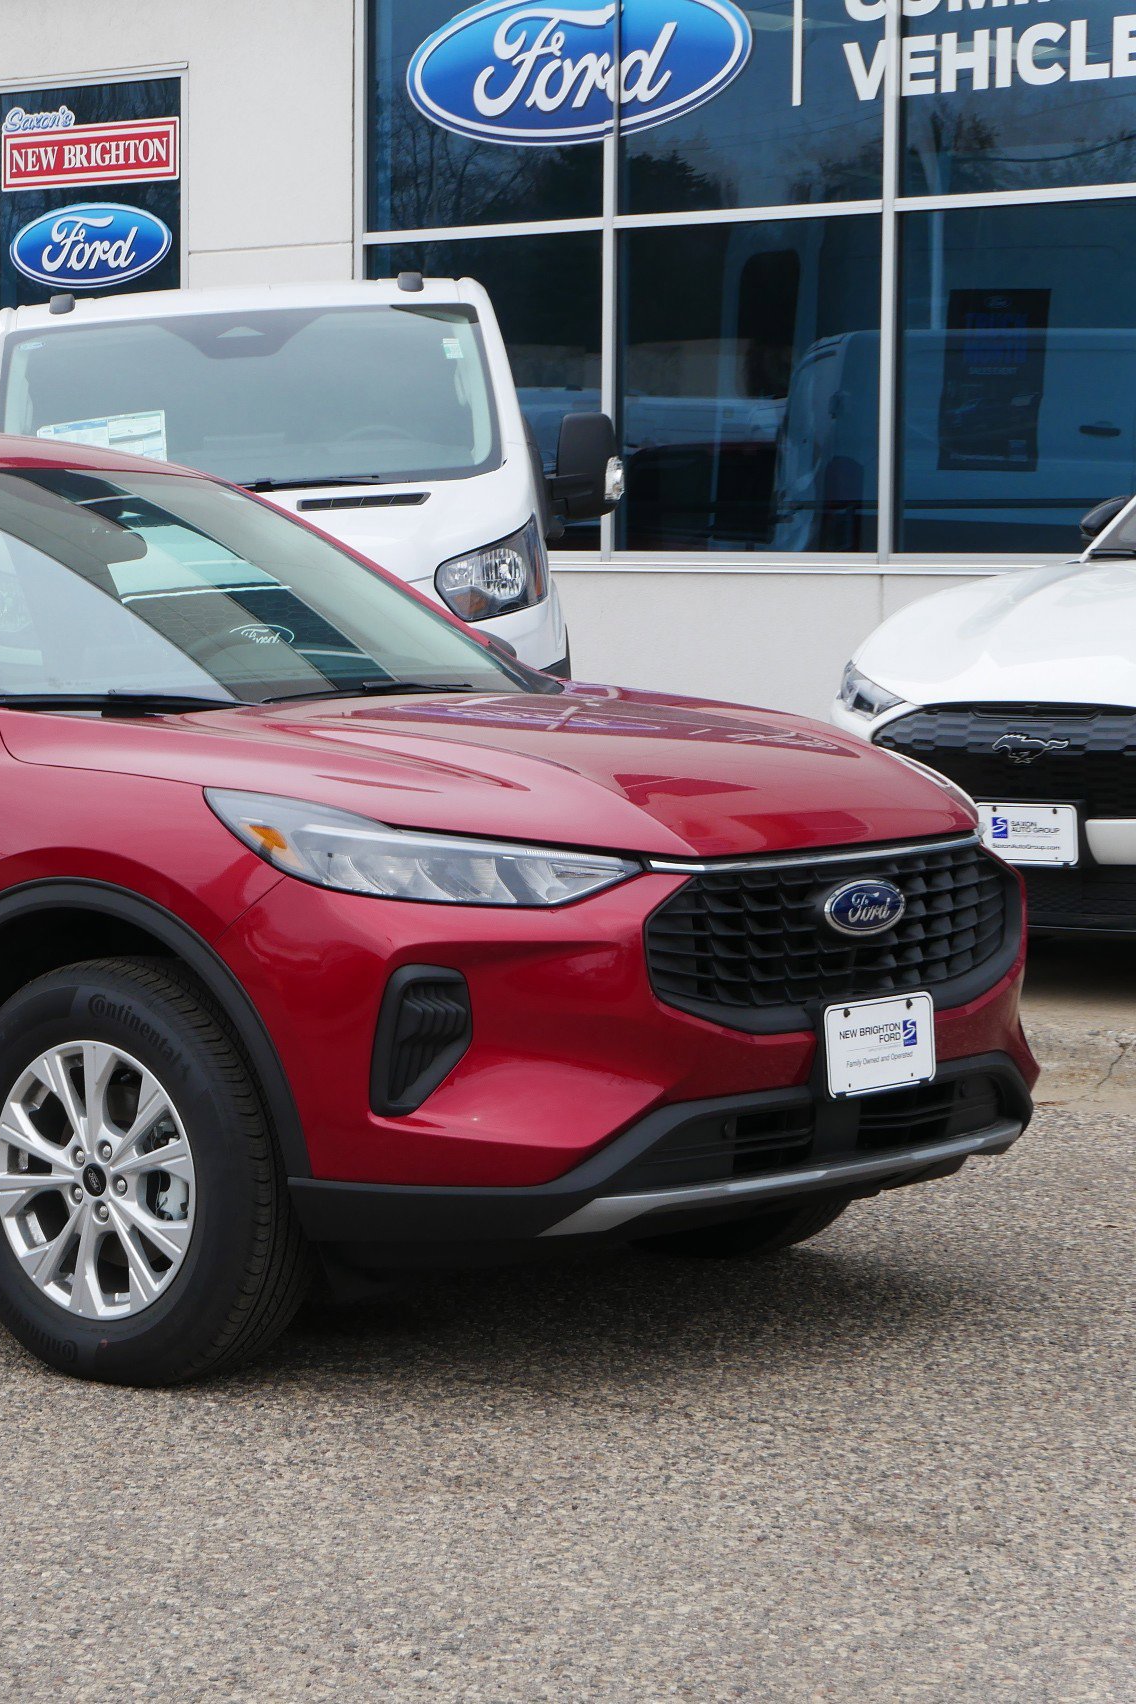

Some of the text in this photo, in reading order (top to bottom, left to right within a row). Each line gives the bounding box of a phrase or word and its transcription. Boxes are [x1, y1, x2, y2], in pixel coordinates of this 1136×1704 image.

[472, 3, 679, 117] Ford
[842, 13, 1136, 101] VEHICLE
[4, 108, 74, 133] Saxon's
[11, 137, 168, 174] NEW BRIGHTON
[41, 215, 139, 273] Ford
[1033, 826, 1061, 834] GROUP
[848, 892, 891, 923] Ford
[88, 993, 184, 1067] Continental
[839, 1022, 901, 1040] NEW BRIGHTON
[879, 1032, 901, 1043] FORD
[846, 1060, 862, 1068] Family
[862, 1056, 880, 1065] Owned
[891, 1051, 913, 1060] Operated
